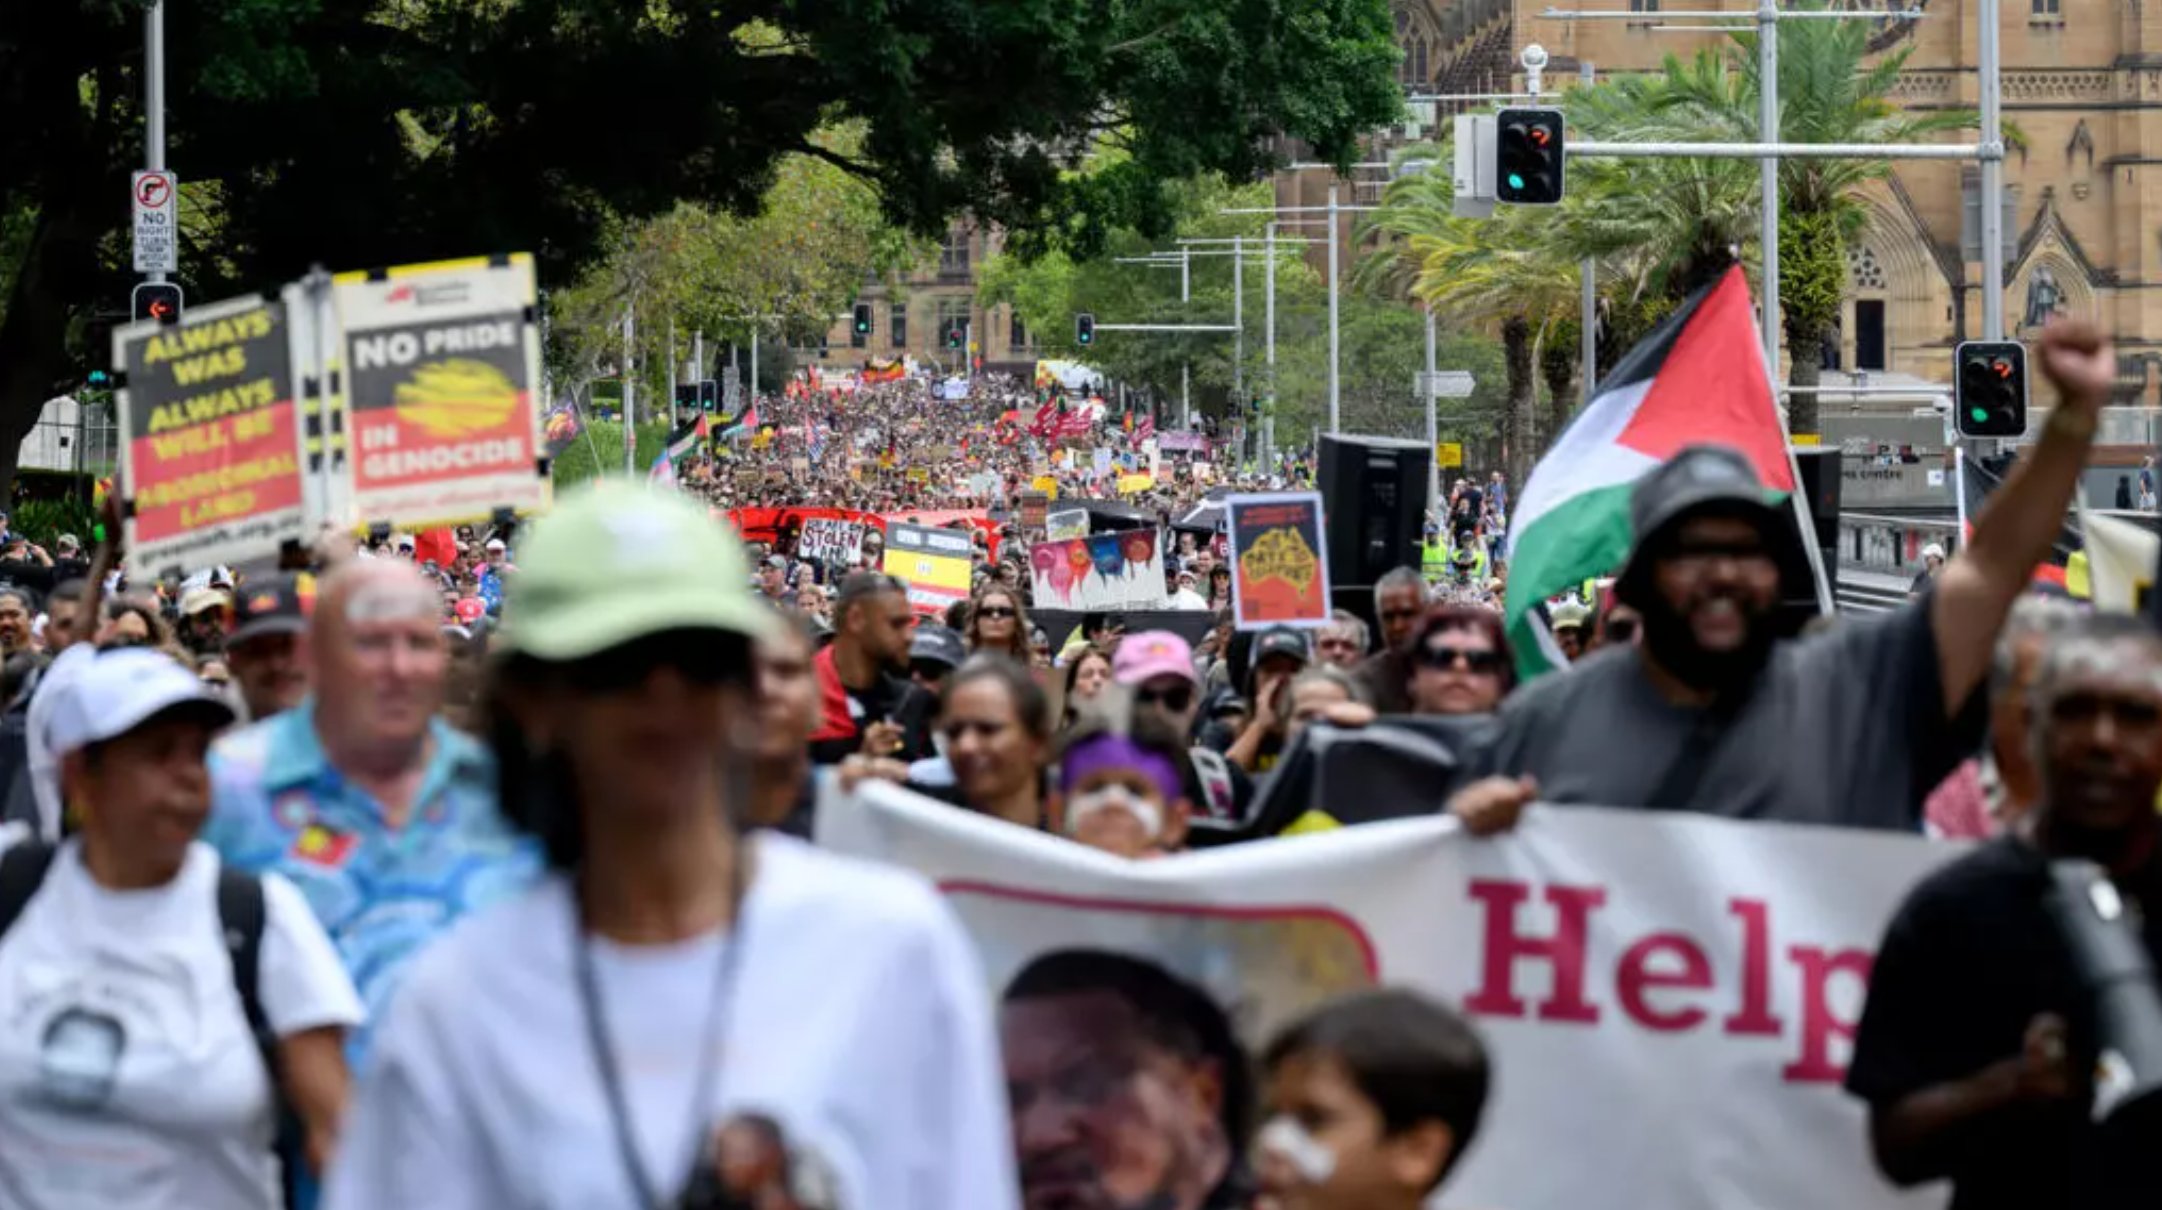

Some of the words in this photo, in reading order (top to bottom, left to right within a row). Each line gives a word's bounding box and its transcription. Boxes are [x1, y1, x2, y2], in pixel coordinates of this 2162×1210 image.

[137, 227, 169, 236] RIGHT
[143, 213, 165, 225] NO
[144, 309, 272, 365] ALWAYS
[354, 332, 420, 370] NO
[424, 321, 516, 355] PRIDE
[172, 346, 246, 386] WAS
[148, 377, 275, 434] ALWAYS
[152, 422, 227, 462] WILL
[234, 408, 274, 442] BE
[362, 424, 398, 450] IN
[363, 436, 523, 480] GENOCIDE
[135, 453, 297, 513] ABORIGINAL
[180, 490, 256, 529] LAND
[803, 528, 858, 548] STOLEN
[1462, 877, 1877, 1084] Help
